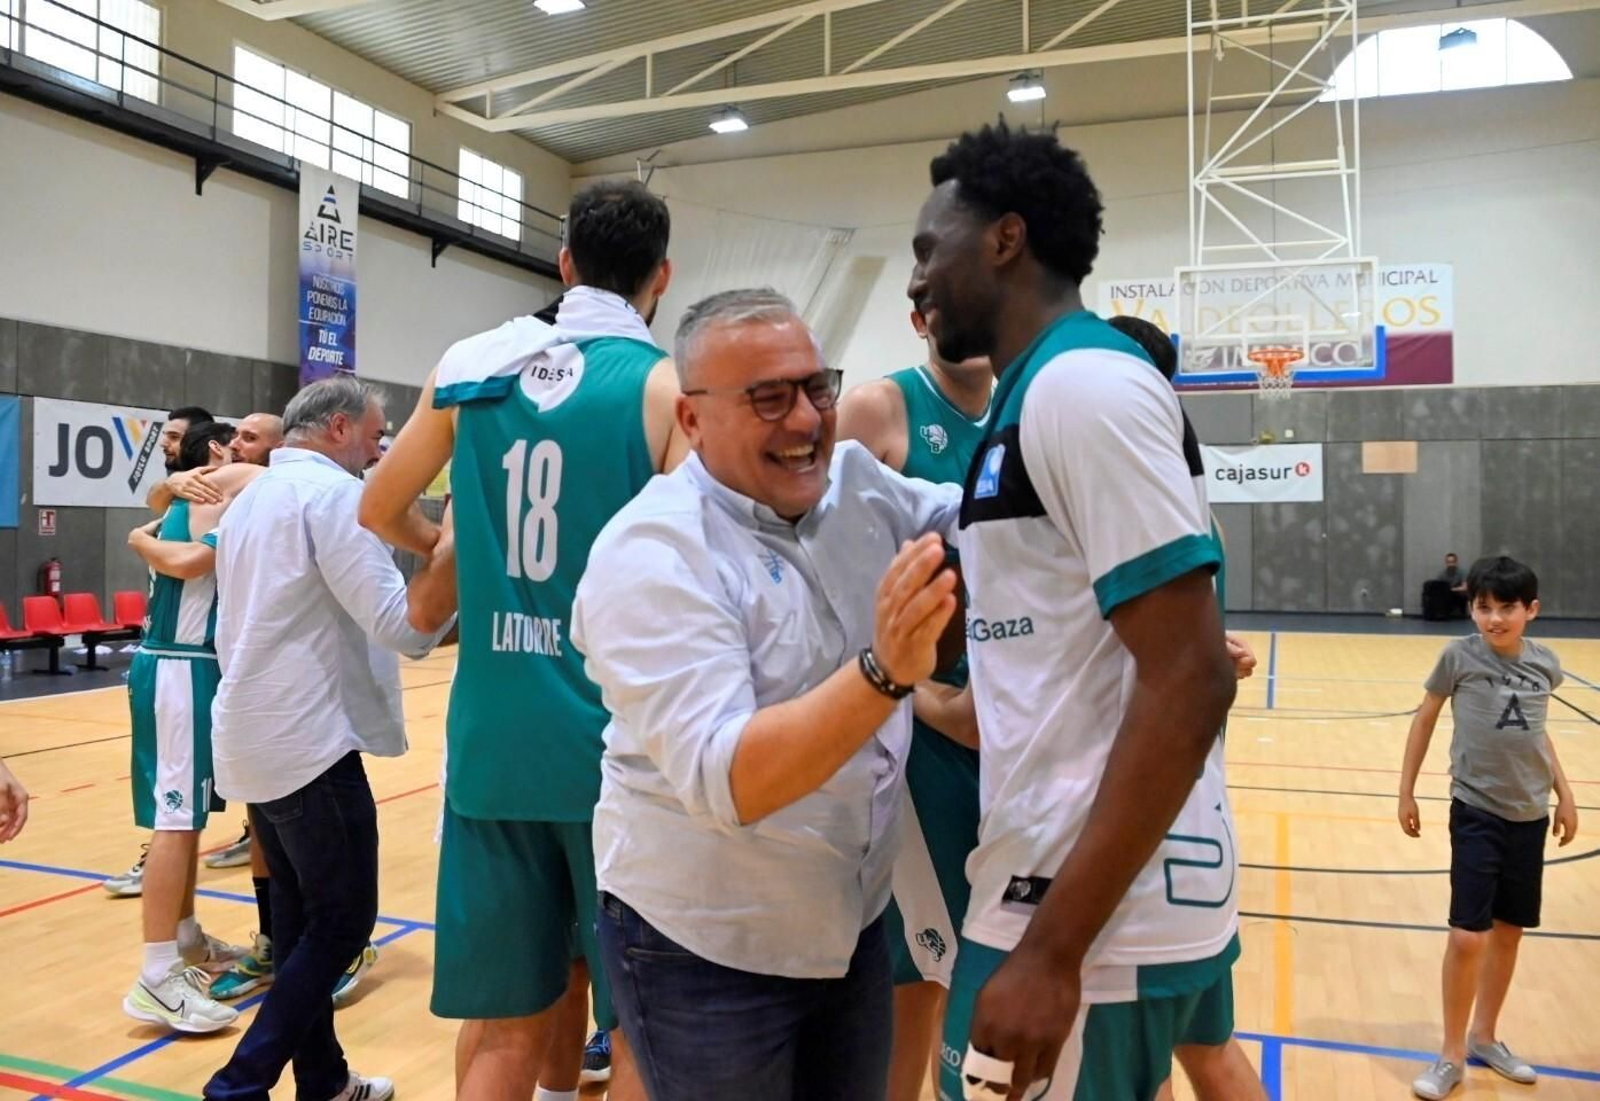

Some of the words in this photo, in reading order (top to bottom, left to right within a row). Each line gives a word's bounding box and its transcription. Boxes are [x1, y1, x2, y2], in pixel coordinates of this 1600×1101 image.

[304, 220, 354, 252] AIRE
[302, 240, 354, 265] SPORT
[1110, 275, 1225, 299] INSTALACÓN
[328, 331, 338, 347] EL
[307, 345, 345, 366] DEPORTE
[1215, 463, 1292, 485] cajasur
[501, 438, 563, 582] 18
[492, 610, 563, 657] LATORRE
